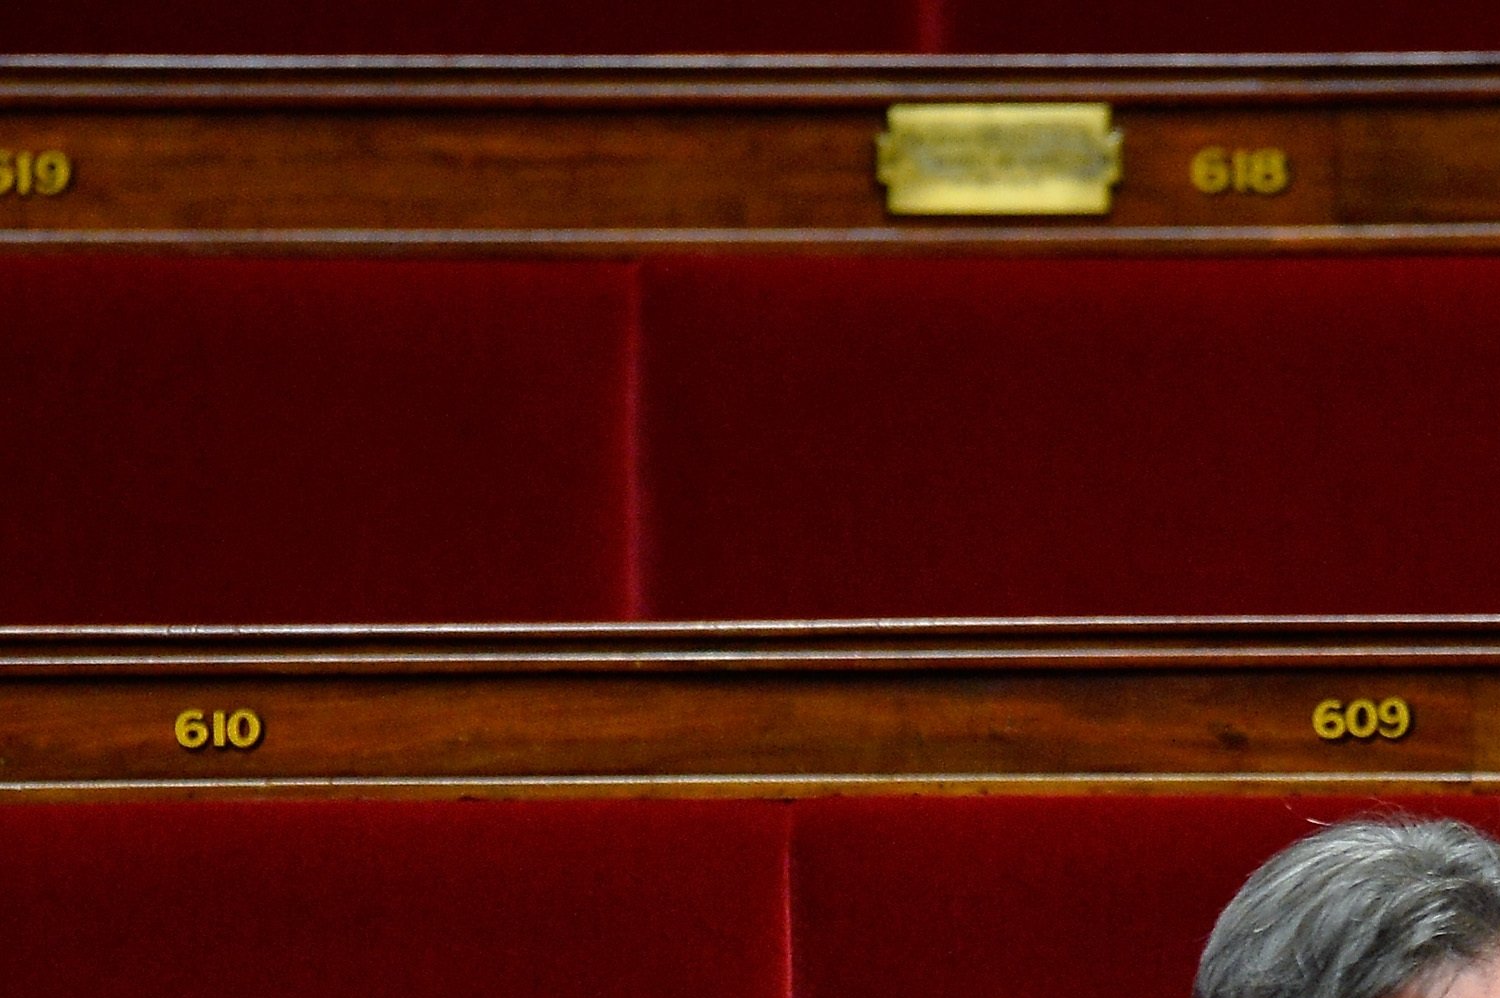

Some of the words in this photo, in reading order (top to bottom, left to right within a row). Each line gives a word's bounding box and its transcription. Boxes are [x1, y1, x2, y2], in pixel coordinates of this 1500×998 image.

[1190, 146, 1287, 193] 618
[175, 709, 260, 748] 610
[1312, 698, 1410, 739] 609
